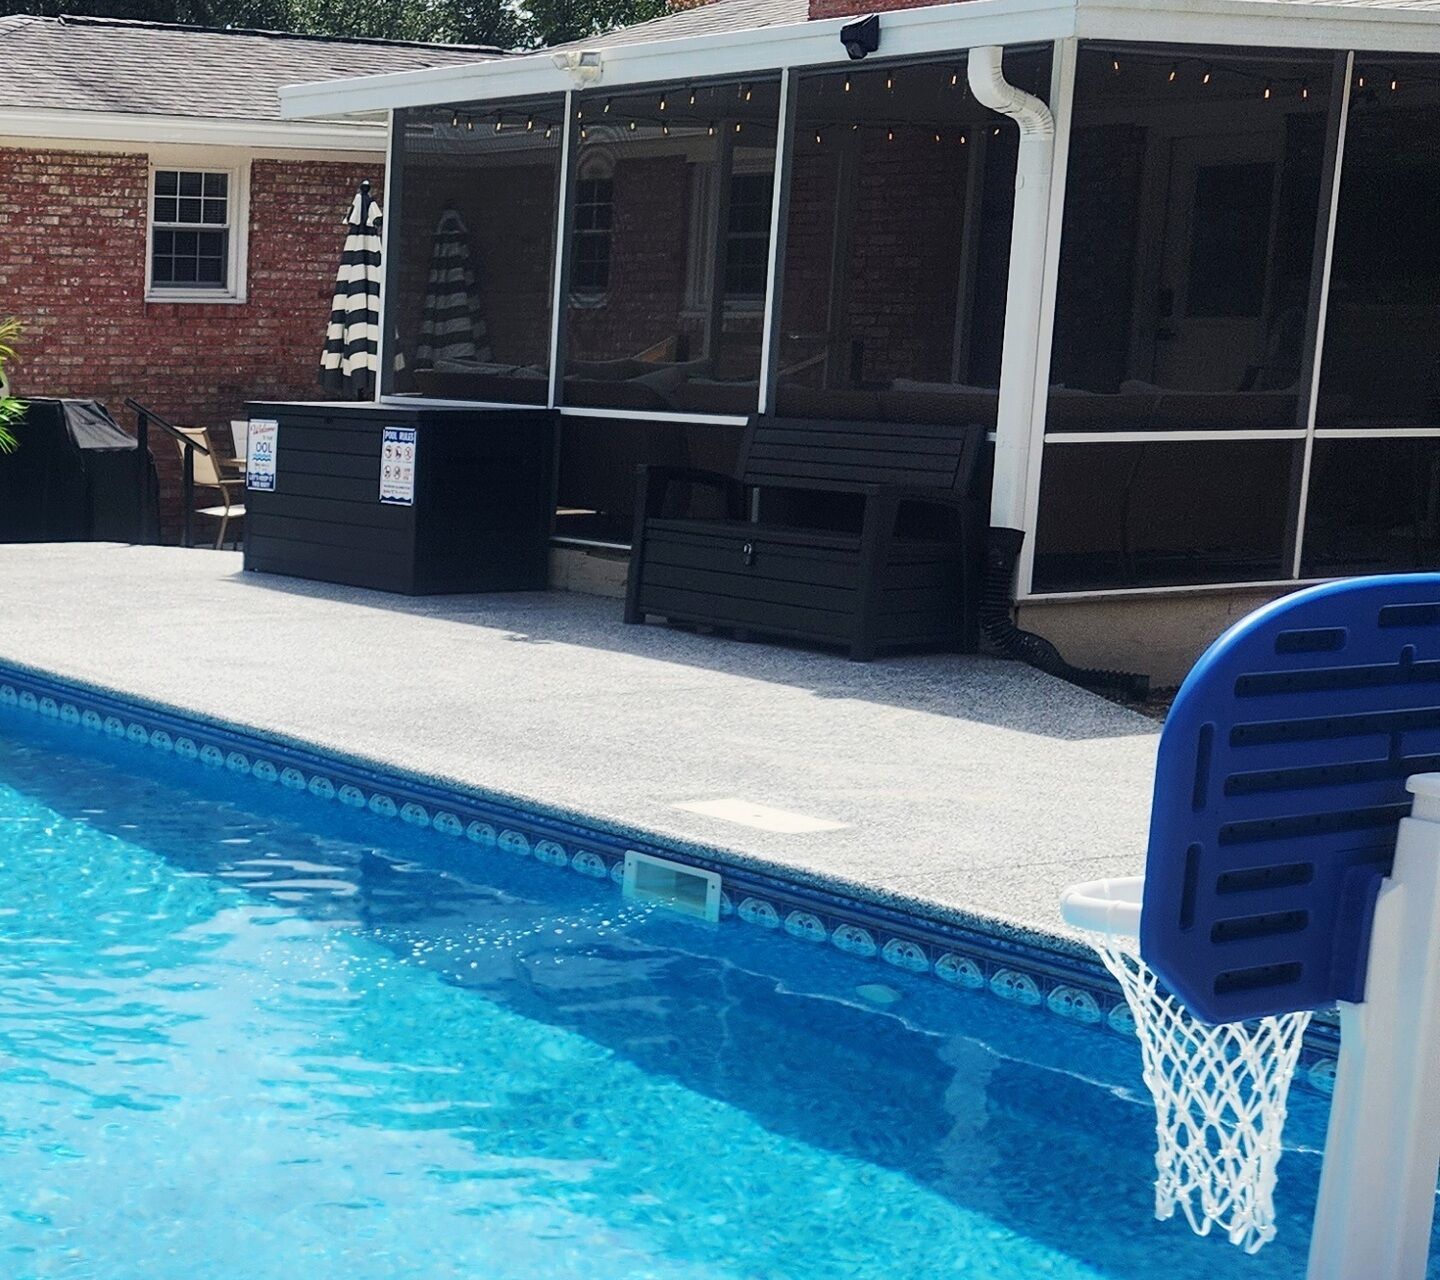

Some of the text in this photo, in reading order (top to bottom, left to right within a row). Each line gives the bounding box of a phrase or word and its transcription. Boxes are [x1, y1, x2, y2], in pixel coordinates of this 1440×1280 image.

[384, 431, 414, 441] POOL RULES
[256, 441, 272, 453] OOL
